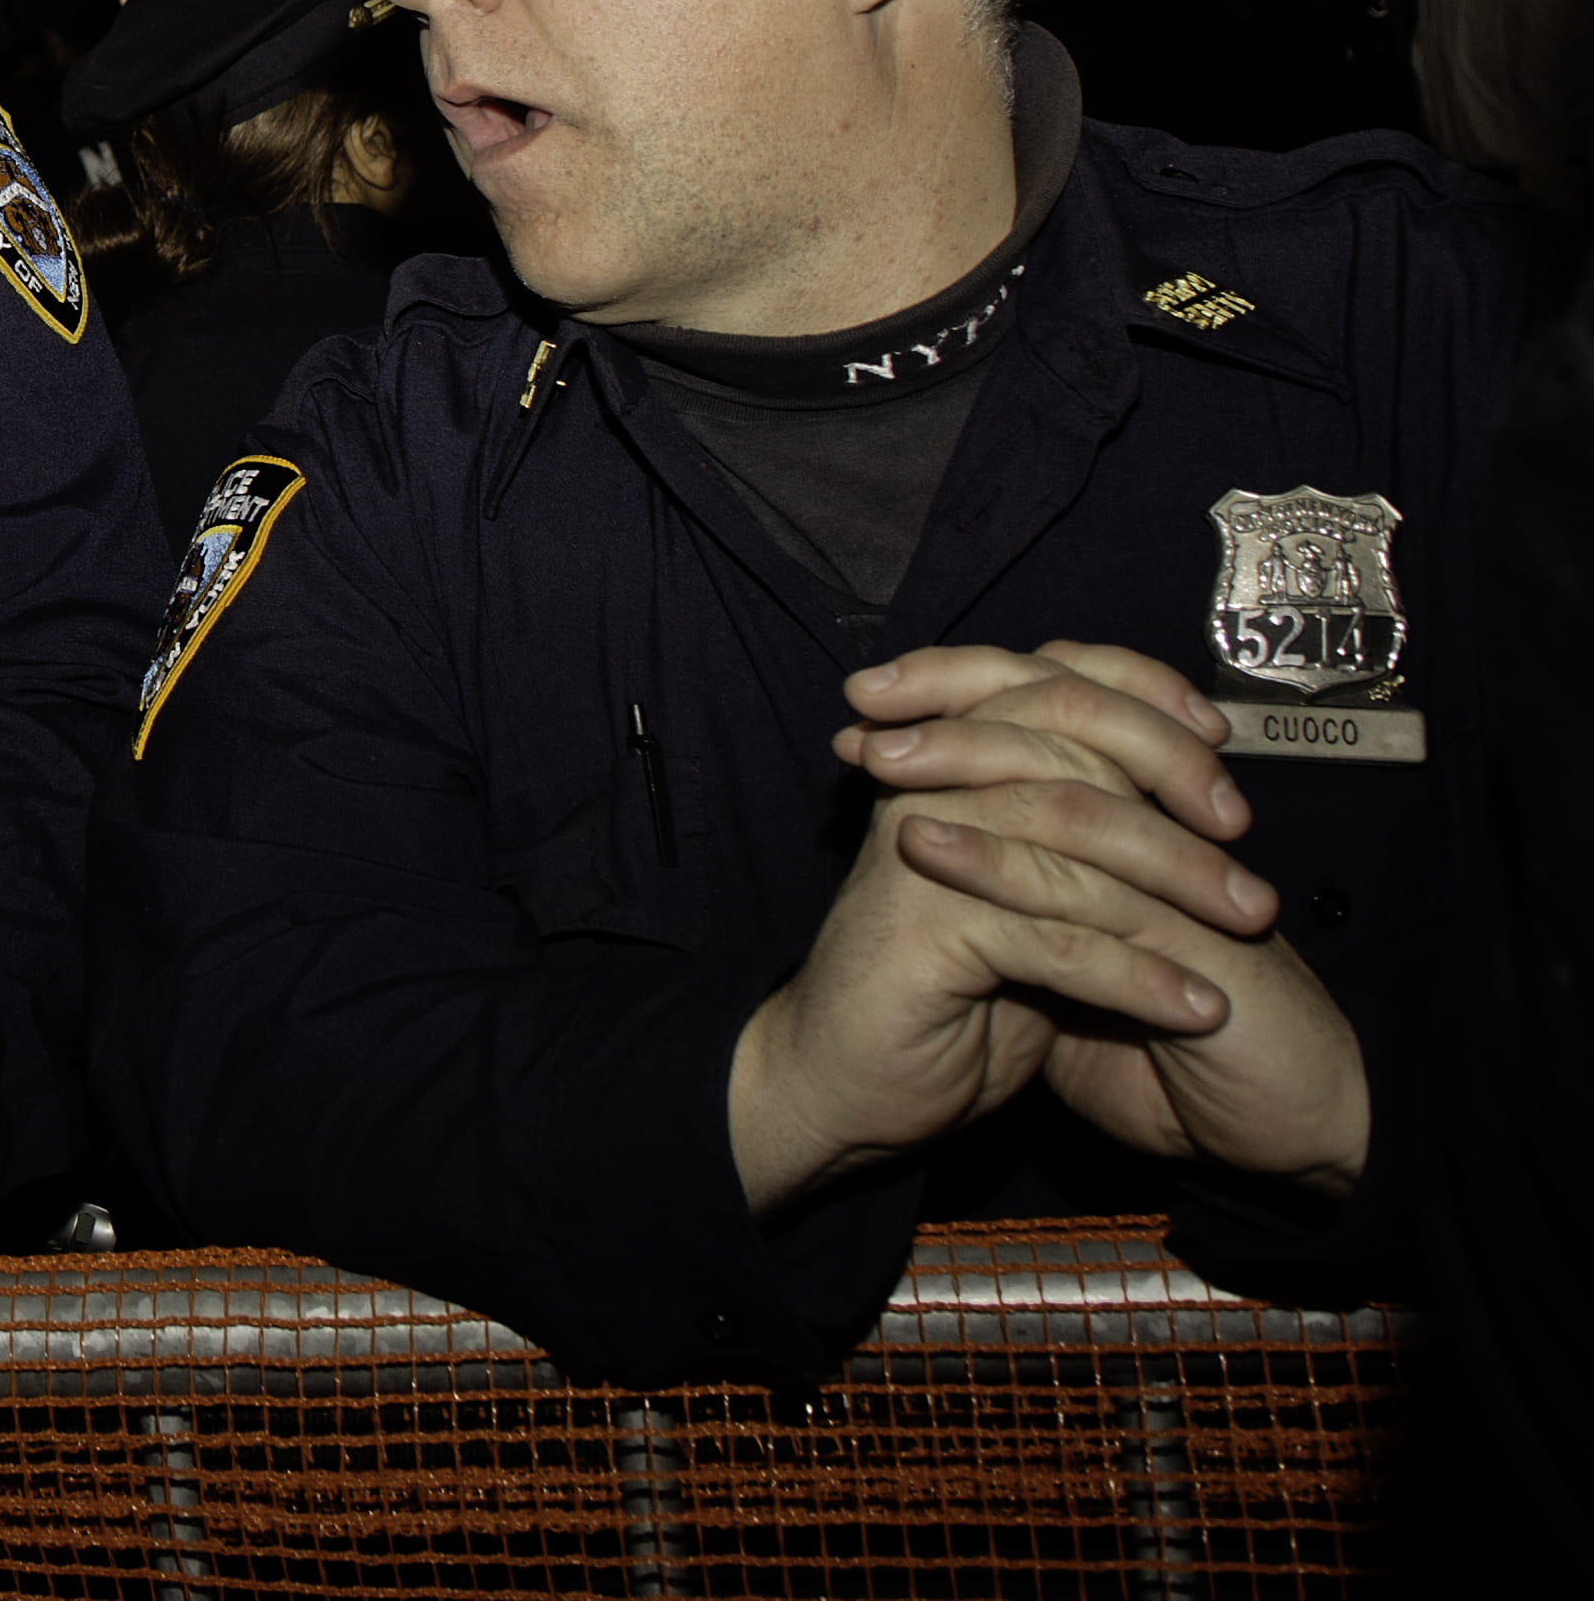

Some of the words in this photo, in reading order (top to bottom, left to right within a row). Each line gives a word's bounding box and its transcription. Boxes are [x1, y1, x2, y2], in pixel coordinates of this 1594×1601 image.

[14, 258, 43, 295] OF
[1236, 605, 1366, 671] 5214
[1263, 714, 1360, 746] CUOCO
